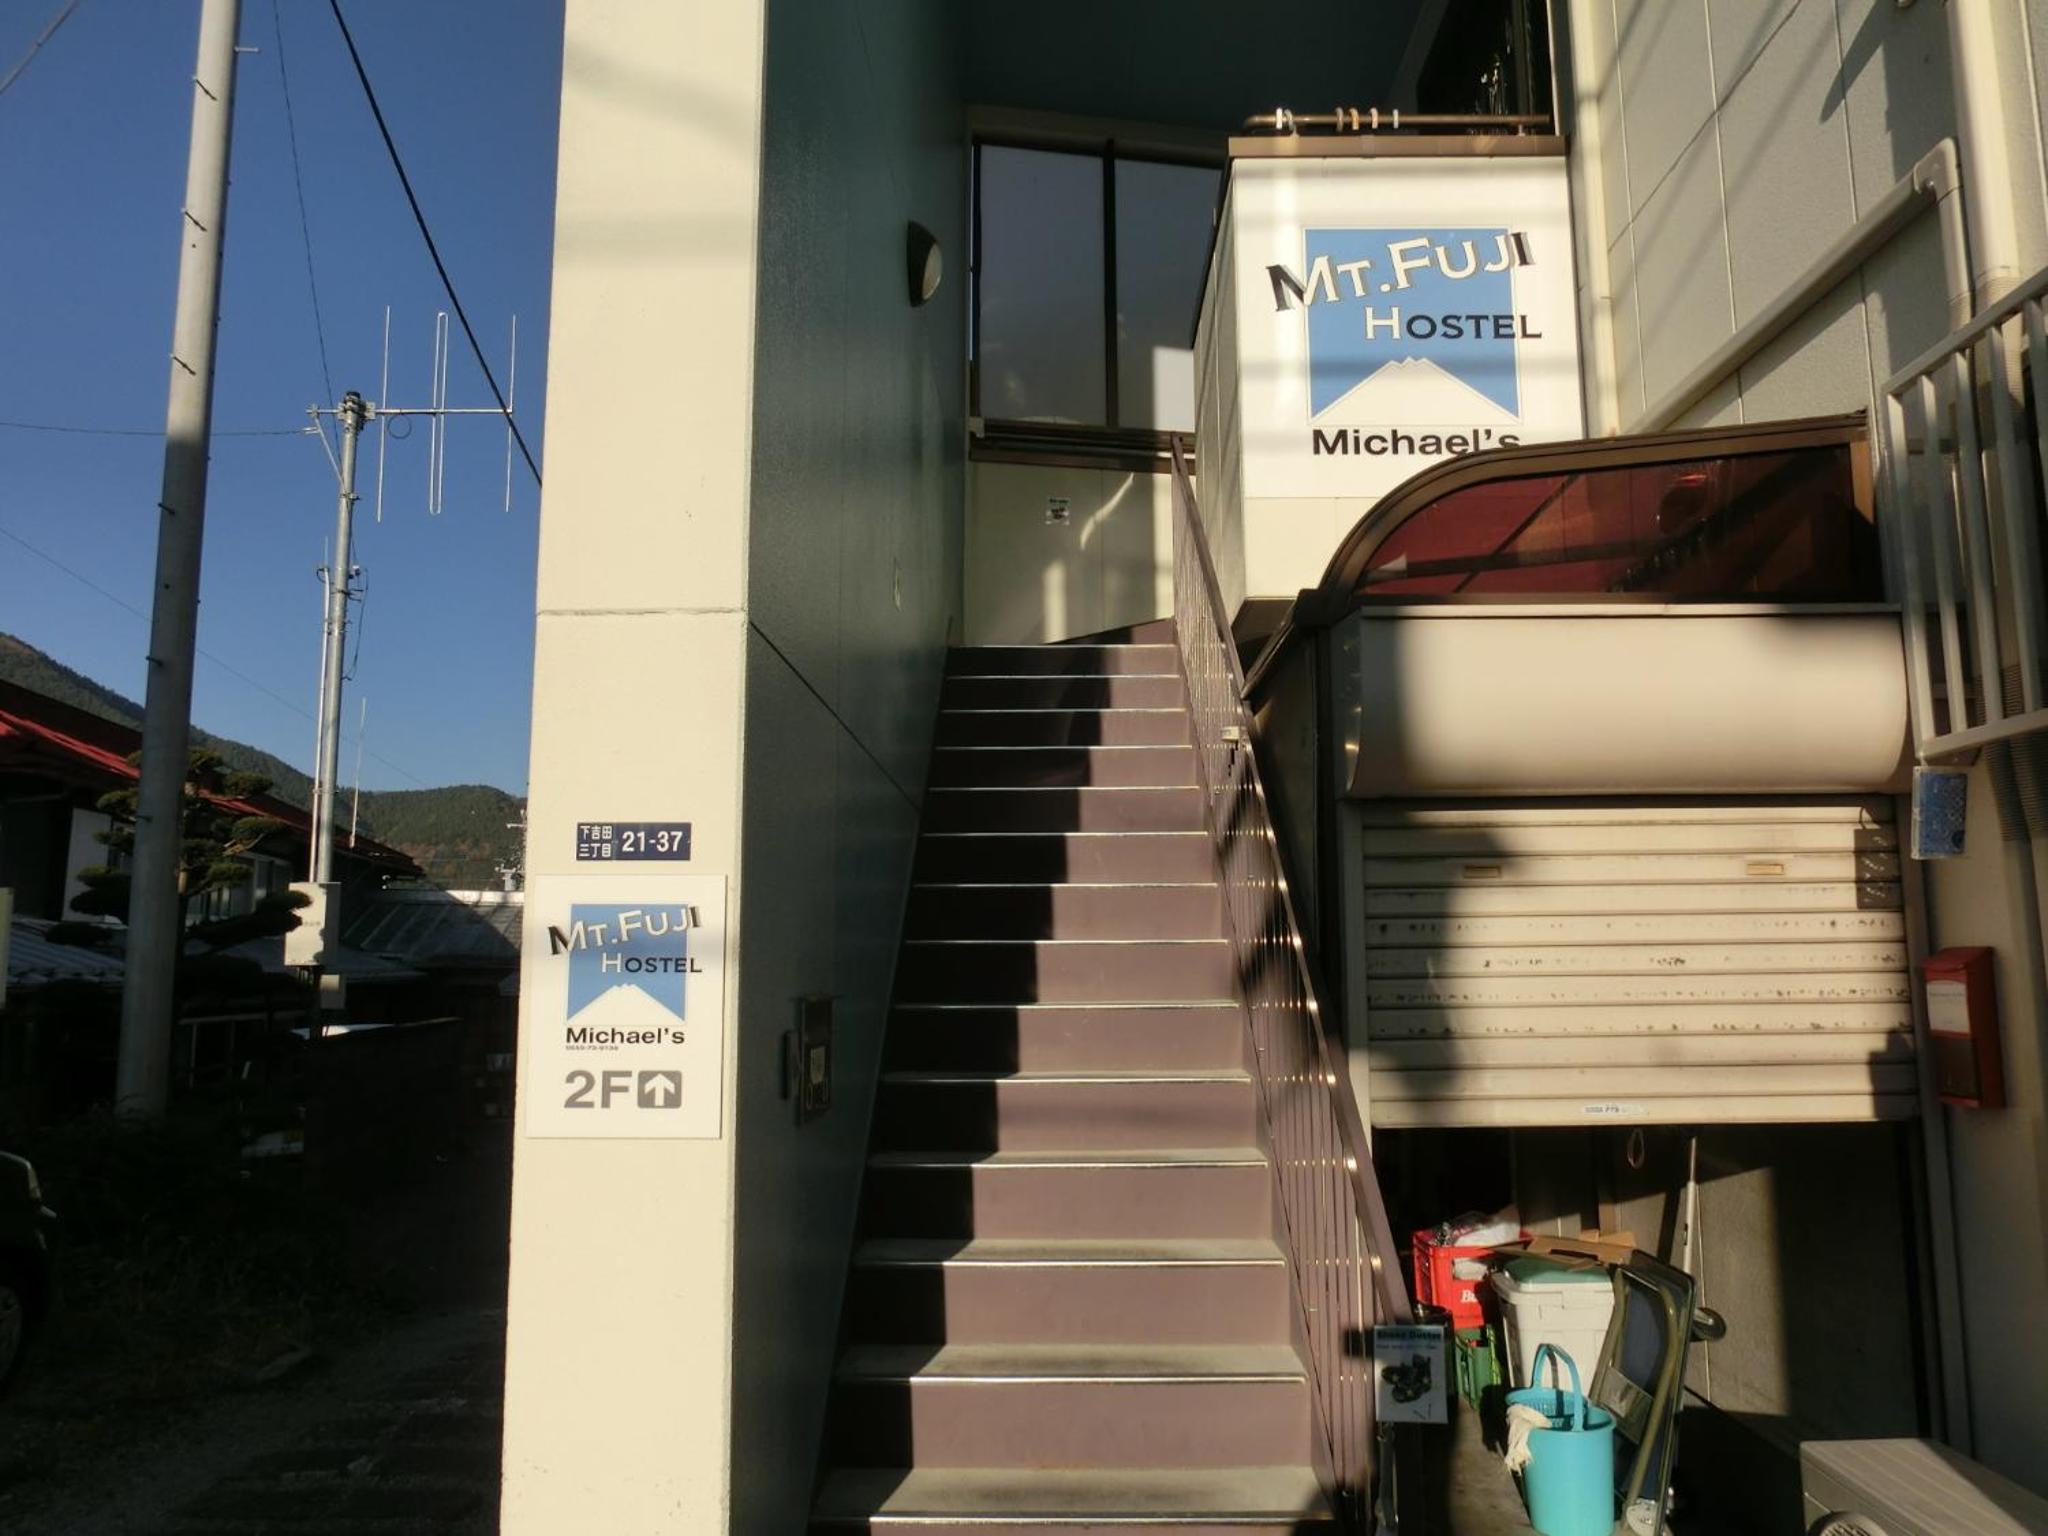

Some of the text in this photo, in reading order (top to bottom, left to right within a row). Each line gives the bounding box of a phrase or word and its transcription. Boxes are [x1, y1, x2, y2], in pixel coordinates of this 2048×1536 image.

[1365, 306, 1542, 339] HOSTEL
[1312, 429, 1520, 455] Michael's
[579, 825, 612, 840] 下吉田
[622, 830, 683, 852] 21-37
[578, 843, 611, 858] 三丁目
[601, 953, 702, 974] HOSTEL
[566, 1027, 685, 1044] Michael's
[564, 1070, 632, 1109] 2F
